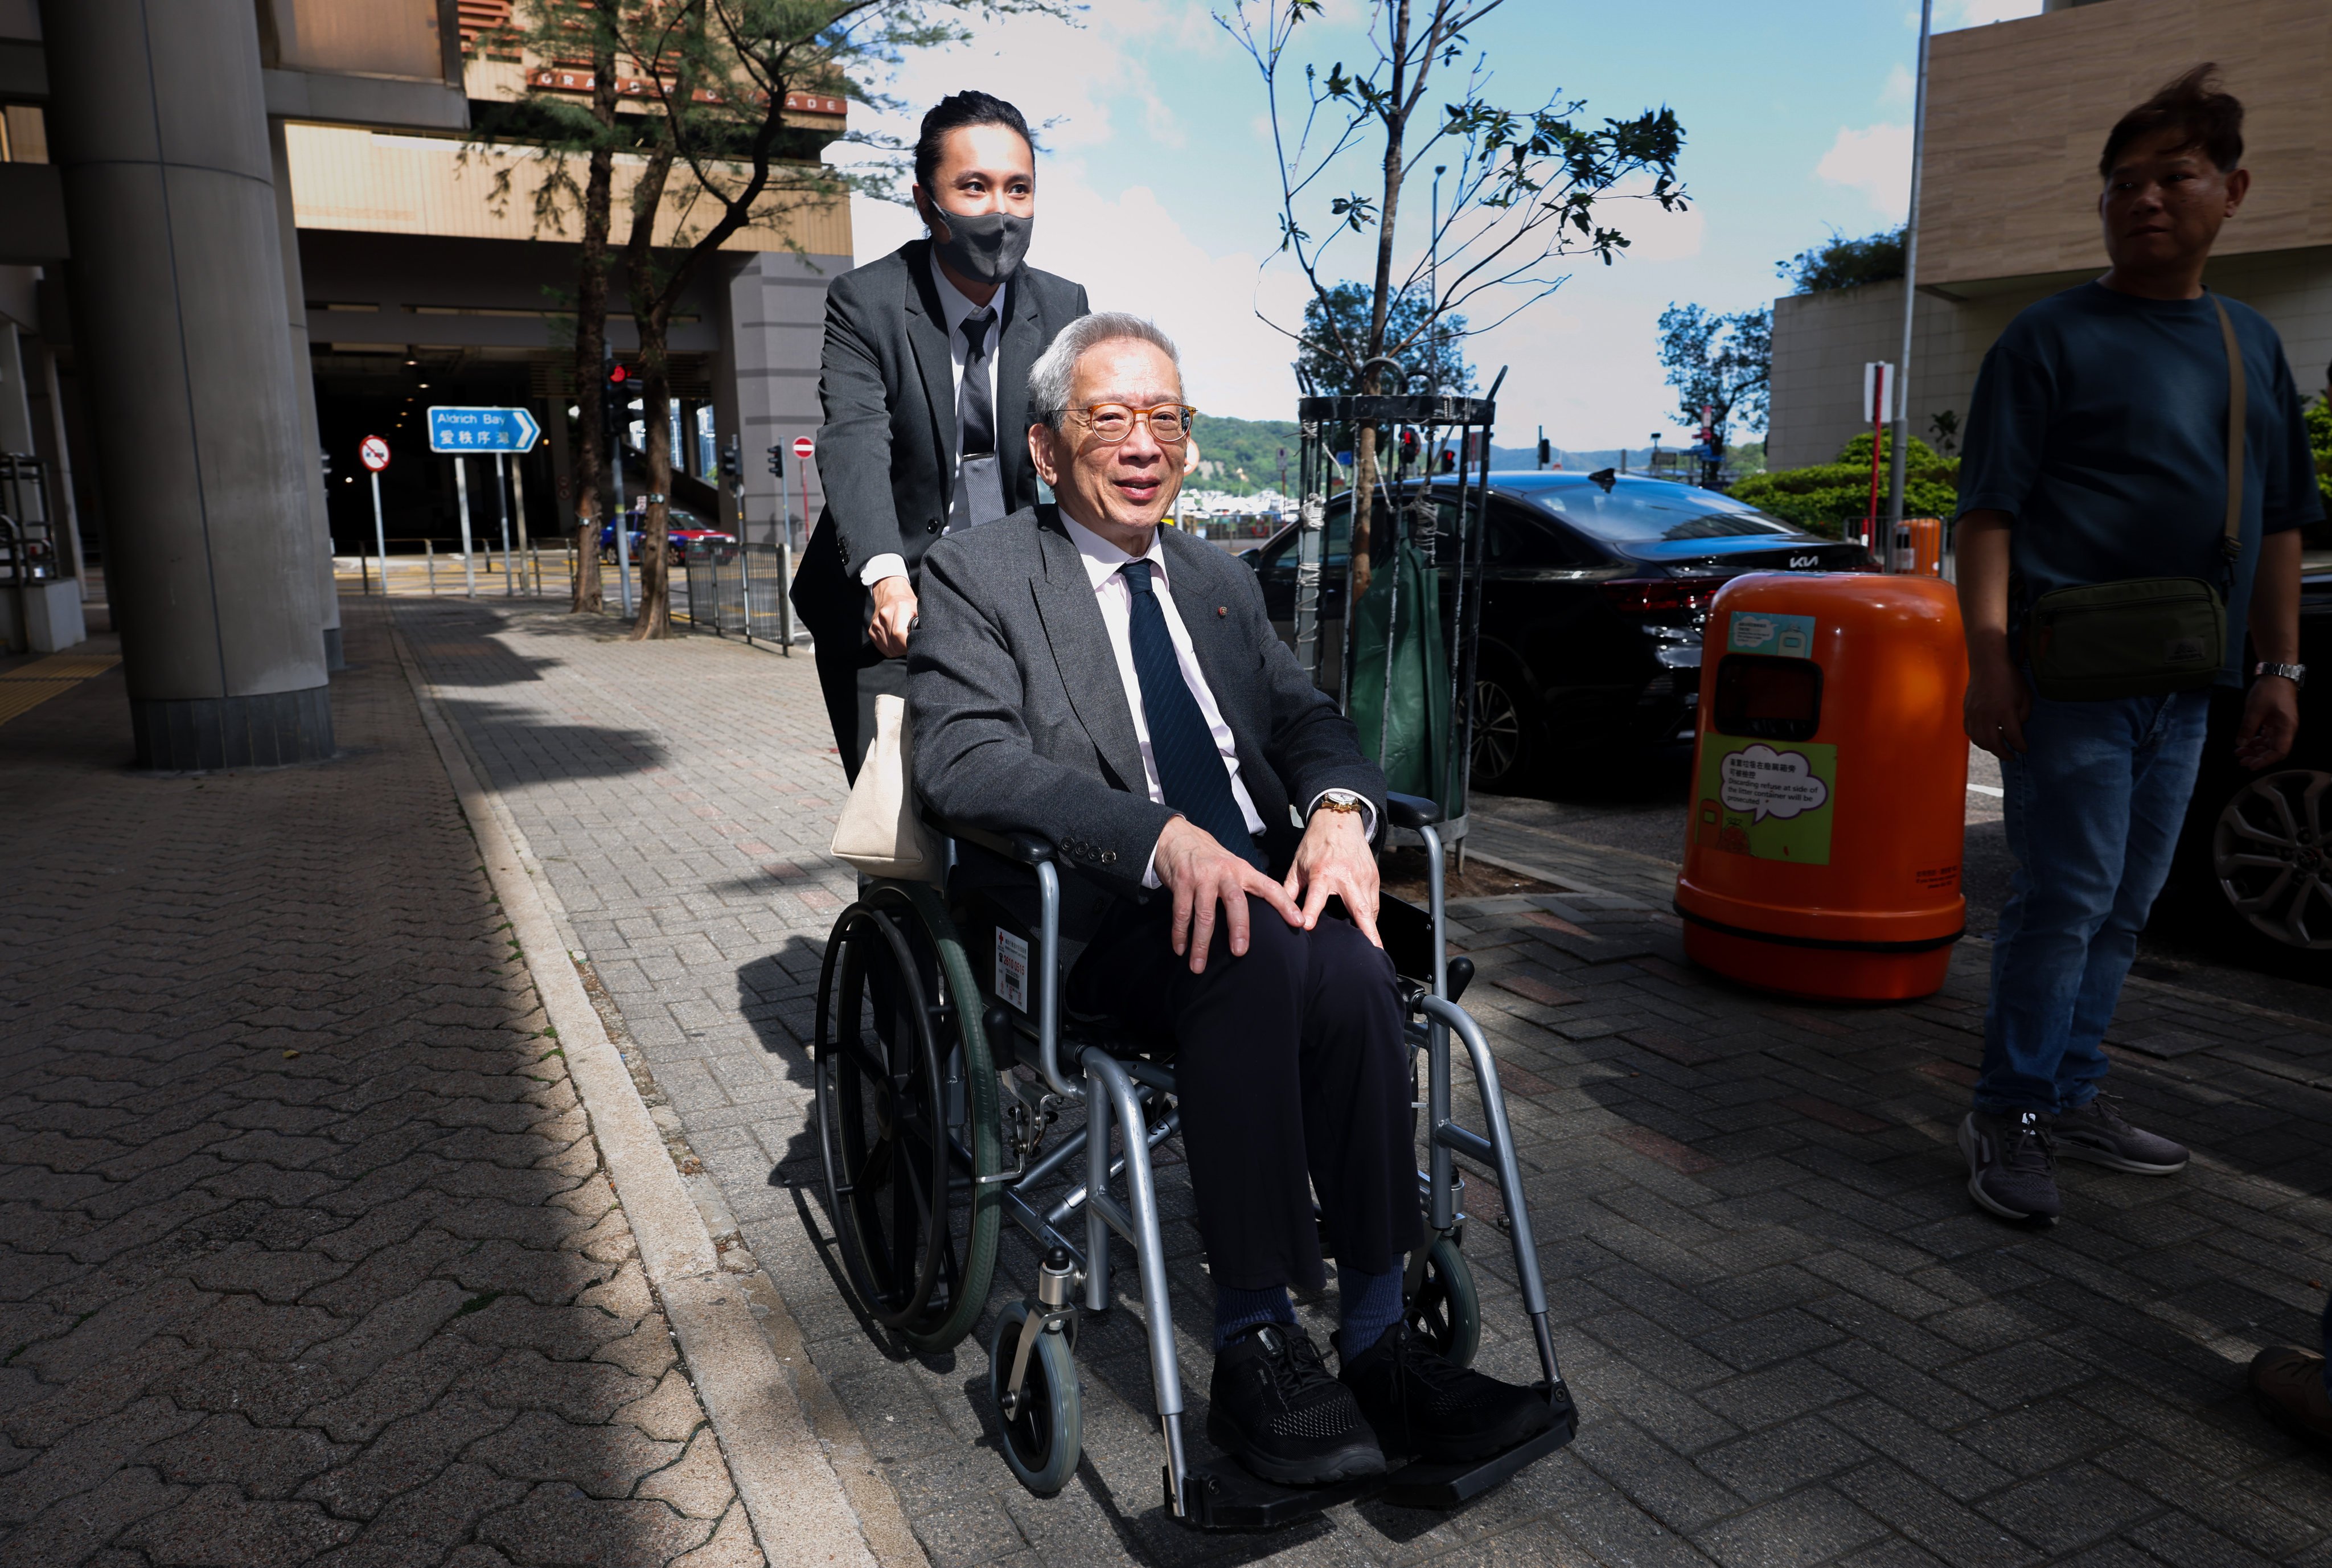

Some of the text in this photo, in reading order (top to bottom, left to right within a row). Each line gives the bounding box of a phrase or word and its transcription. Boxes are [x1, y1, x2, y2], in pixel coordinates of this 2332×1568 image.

[437, 413, 506, 426] Aldrich Bay
[440, 429, 510, 445] 愛秩序灣
[1789, 555, 1819, 568] KIA
[1729, 778, 1759, 789] Discarding
[1760, 782, 1781, 790] refuse
[1793, 784, 1808, 793] side
[1727, 795, 1760, 805] prosecuted
[1754, 789, 1785, 799] container
[1003, 955, 1014, 968] 2610
[1015, 960, 1025, 975] 0515
